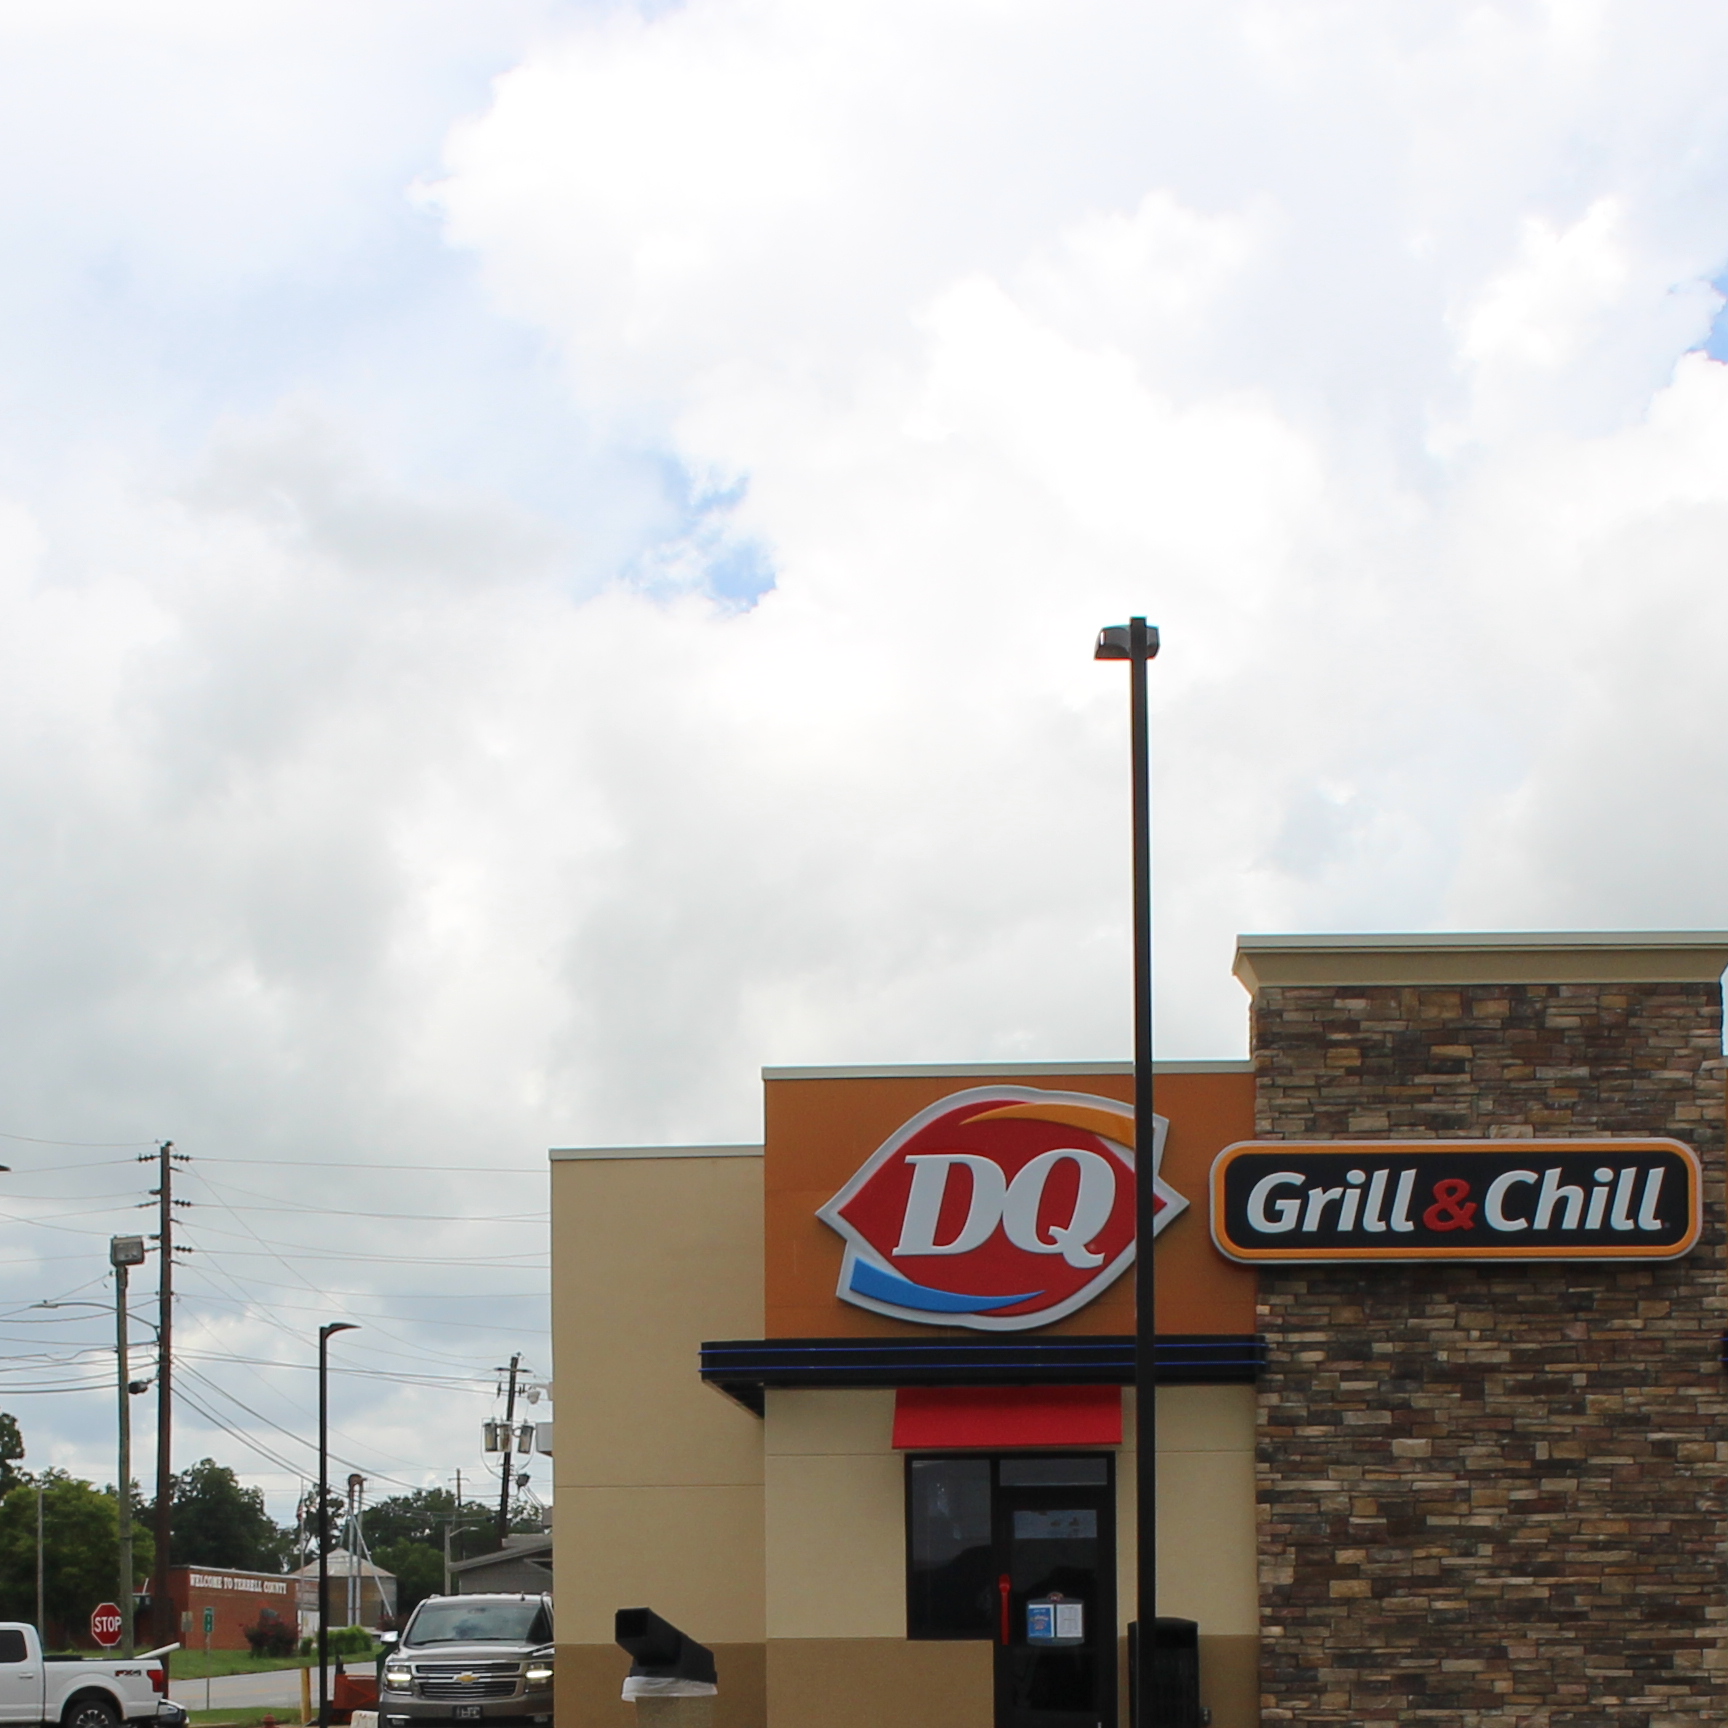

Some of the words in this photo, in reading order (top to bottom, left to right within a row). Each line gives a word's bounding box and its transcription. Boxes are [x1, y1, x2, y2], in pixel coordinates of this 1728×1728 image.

[891, 1148, 1116, 1269] DQ
[1246, 1168, 1418, 1234] Grill
[1422, 1178, 1478, 1231] &
[1483, 1166, 1666, 1232] Chill
[189, 1573, 223, 1589] WELCOME
[223, 1577, 233, 1590] TO
[233, 1578, 263, 1593] TERRELL
[263, 1581, 287, 1594] COUNTY
[94, 1616, 122, 1632] STOP
